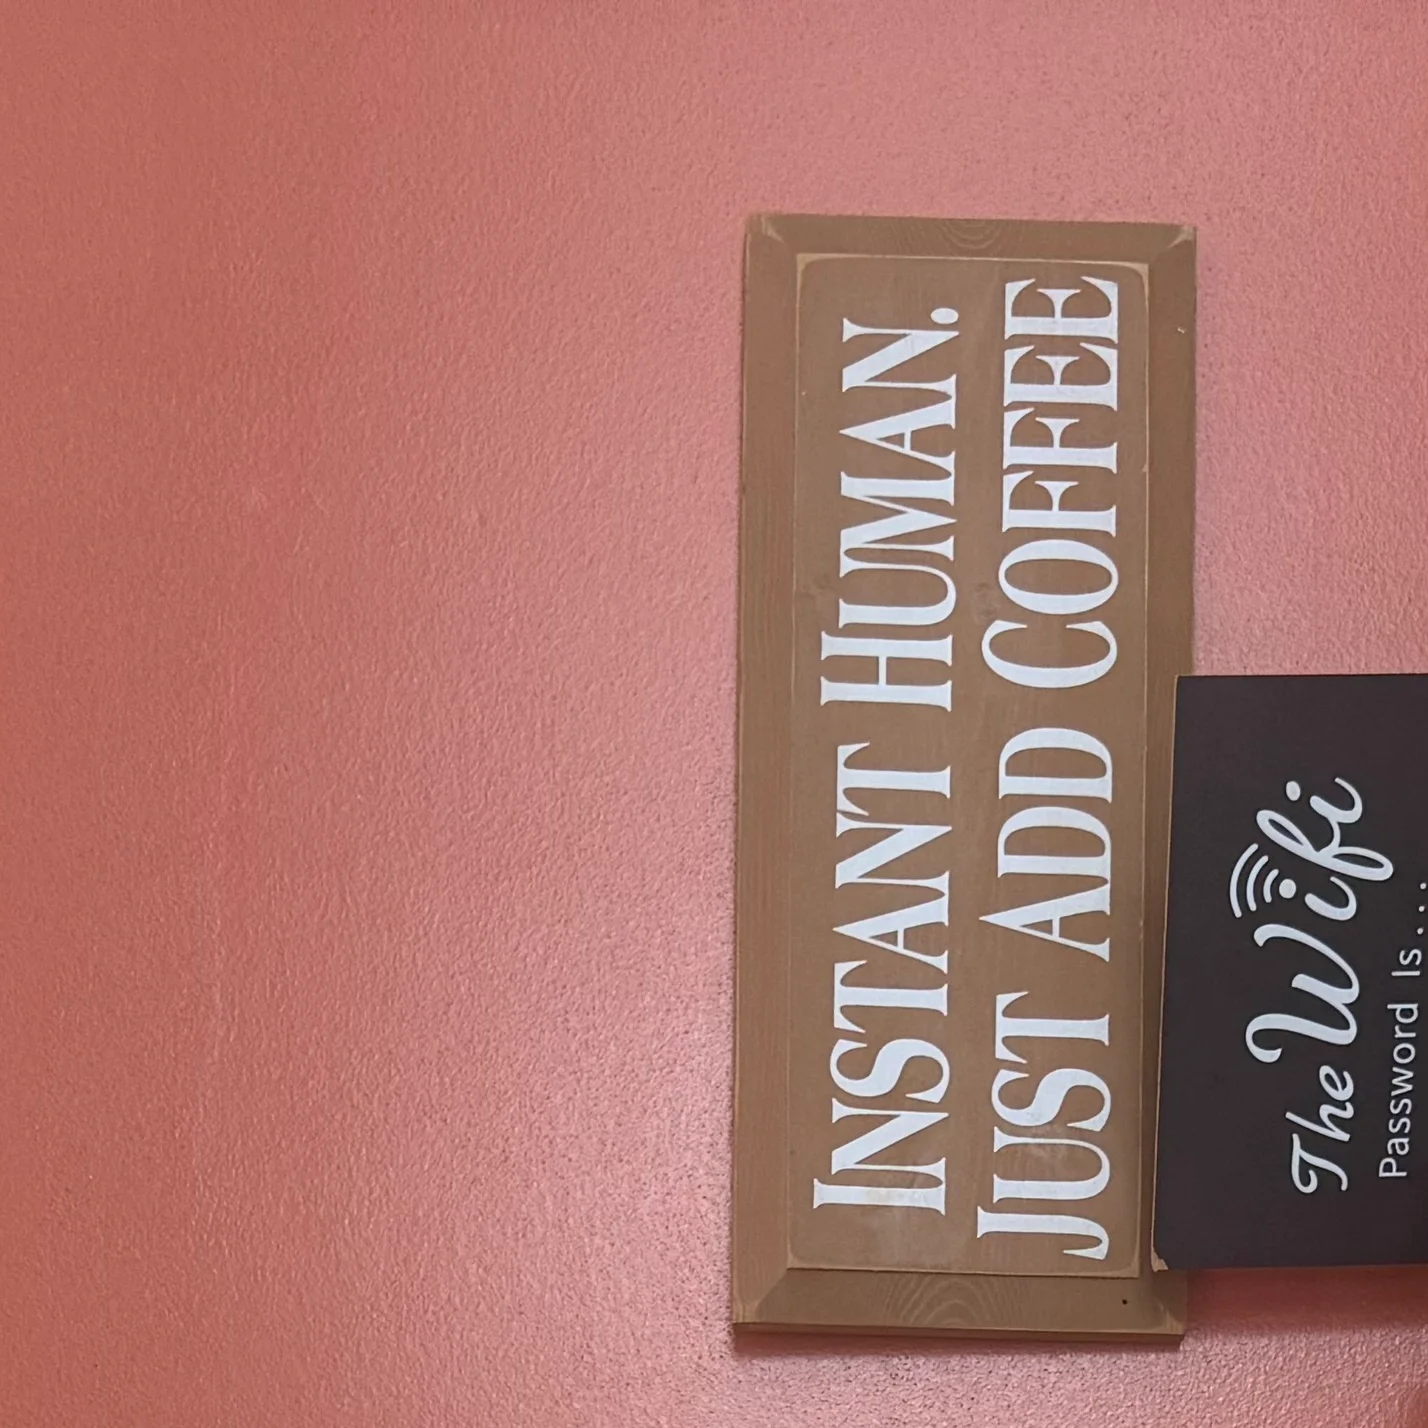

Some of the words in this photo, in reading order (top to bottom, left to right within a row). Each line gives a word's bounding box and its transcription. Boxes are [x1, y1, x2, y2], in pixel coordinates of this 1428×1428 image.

[819, 307, 960, 711] HUMAN.
[980, 276, 1120, 690] COFFEE
[813, 743, 952, 1216] INSTANT
[978, 728, 1113, 962] ADD
[1245, 777, 1393, 1063] Wifi
[976, 992, 1112, 1260] JUST
[1286, 1066, 1354, 1193] The
[1378, 1003, 1420, 1179] Password
